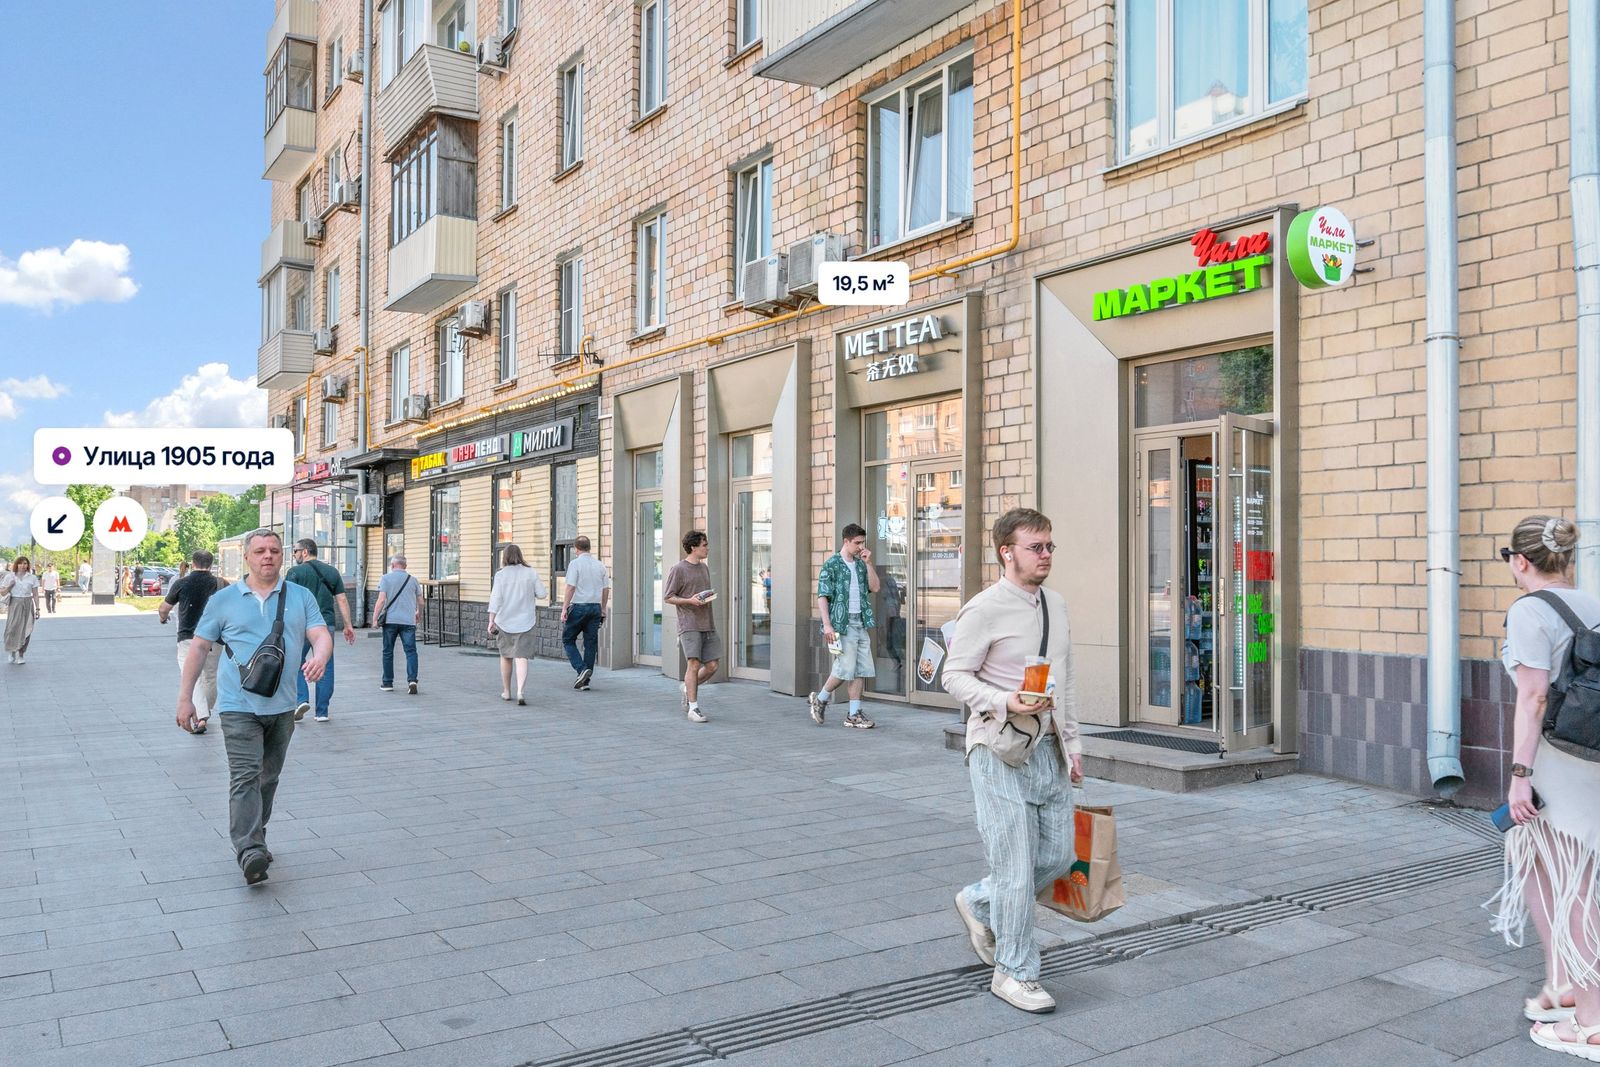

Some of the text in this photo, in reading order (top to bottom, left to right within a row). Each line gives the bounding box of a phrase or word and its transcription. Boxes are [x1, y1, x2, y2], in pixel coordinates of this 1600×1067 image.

[1318, 215, 1346, 239] Чили
[1191, 228, 1270, 266] Чили
[1310, 235, 1354, 254] МАРКЕТ
[1092, 255, 1272, 321] МАРКЕТ
[523, 425, 563, 454] МИЛТИ
[420, 452, 446, 470] ТАБАК
